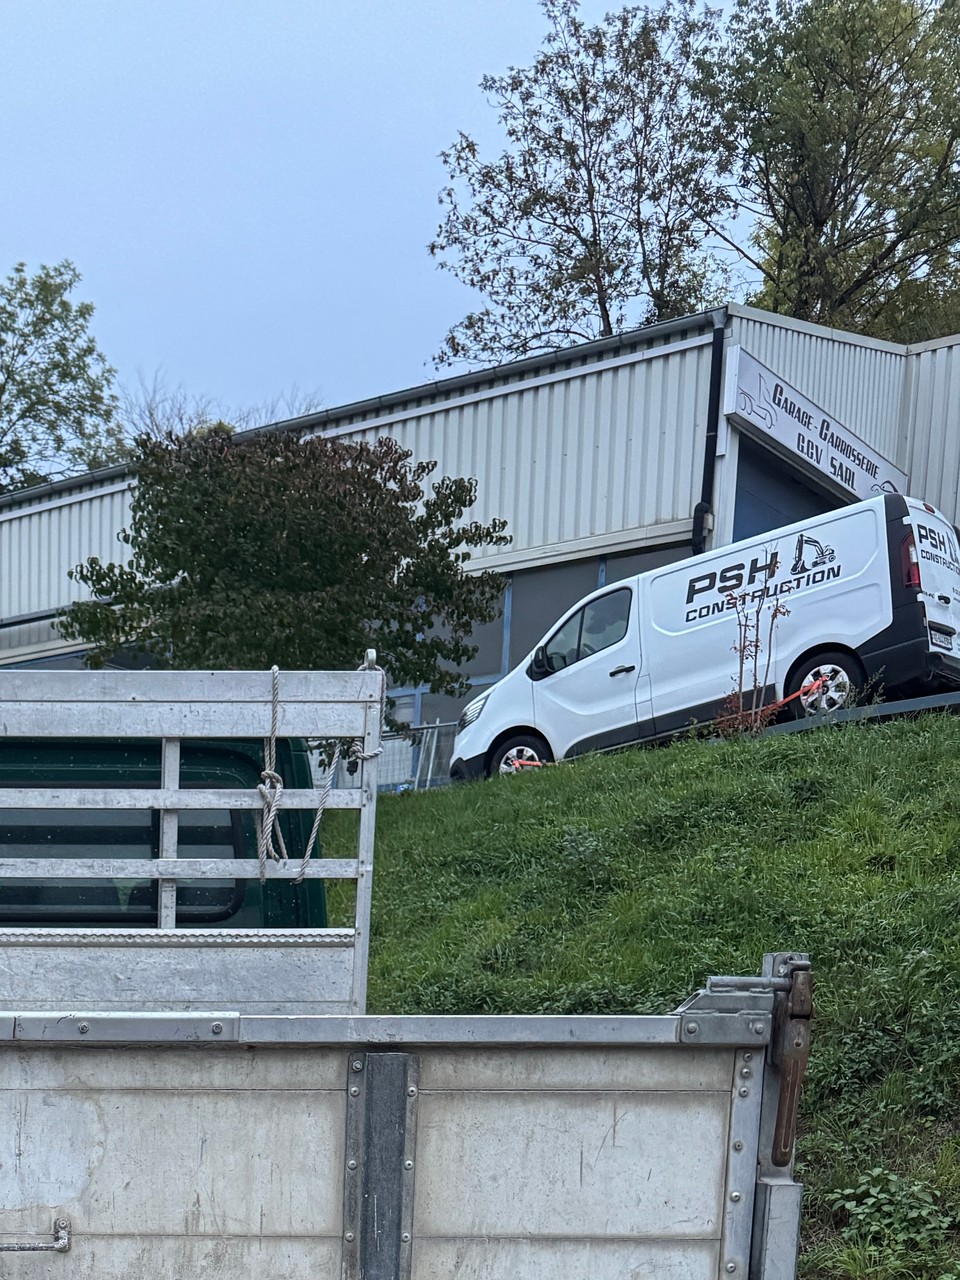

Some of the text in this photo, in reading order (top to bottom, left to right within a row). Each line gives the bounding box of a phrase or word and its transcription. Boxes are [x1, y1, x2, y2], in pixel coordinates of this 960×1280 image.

[829, 456, 857, 492] SARL
[917, 524, 947, 554] PSH
[685, 564, 842, 623] CONSTRUCTION
[686, 551, 779, 605] PSH
